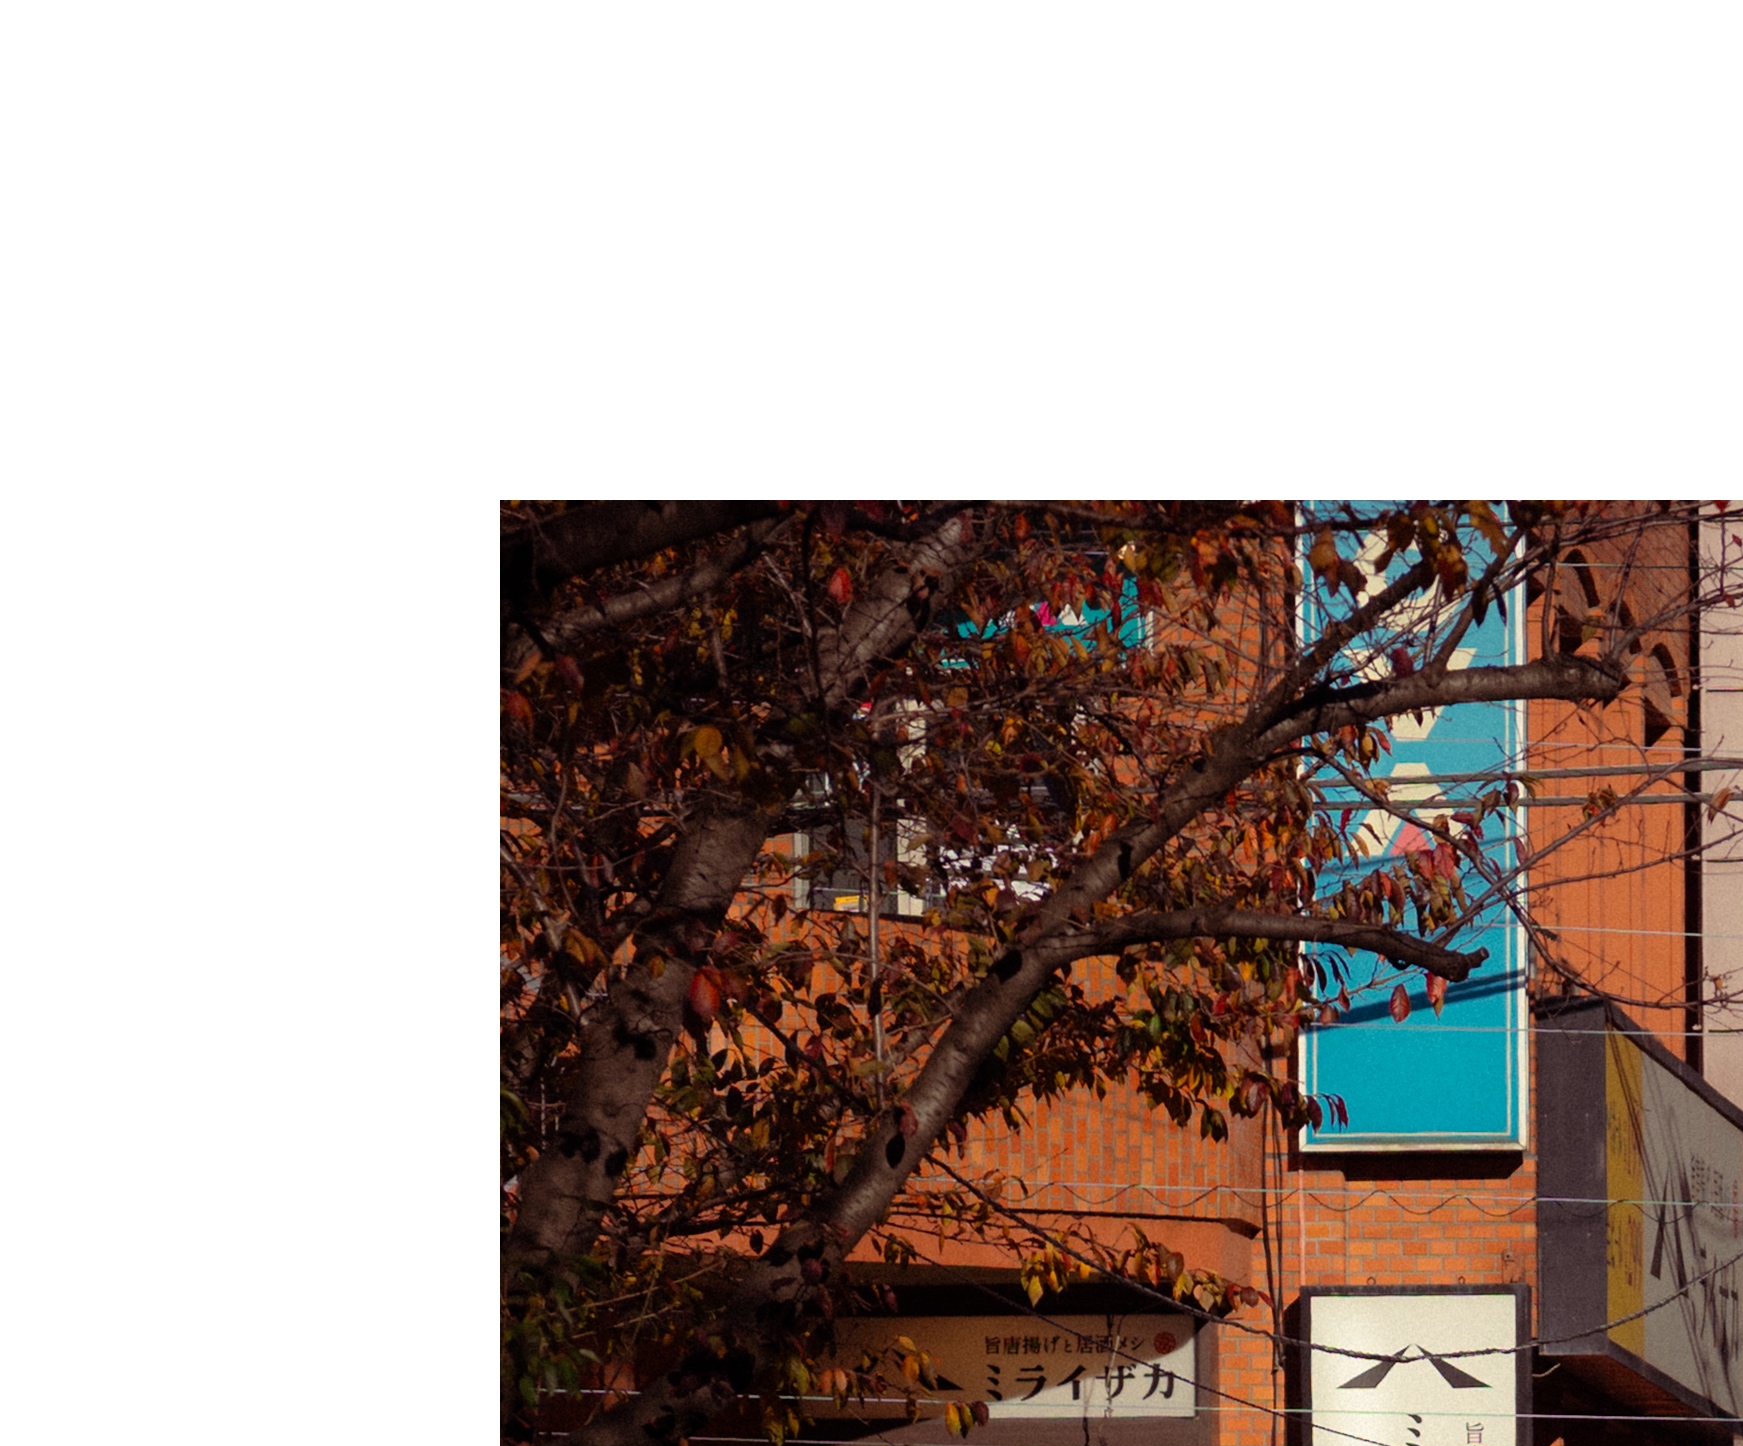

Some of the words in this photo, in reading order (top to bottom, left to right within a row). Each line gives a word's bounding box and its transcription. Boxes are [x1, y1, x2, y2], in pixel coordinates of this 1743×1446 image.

[986, 1363, 1175, 1400] ミライザカ
